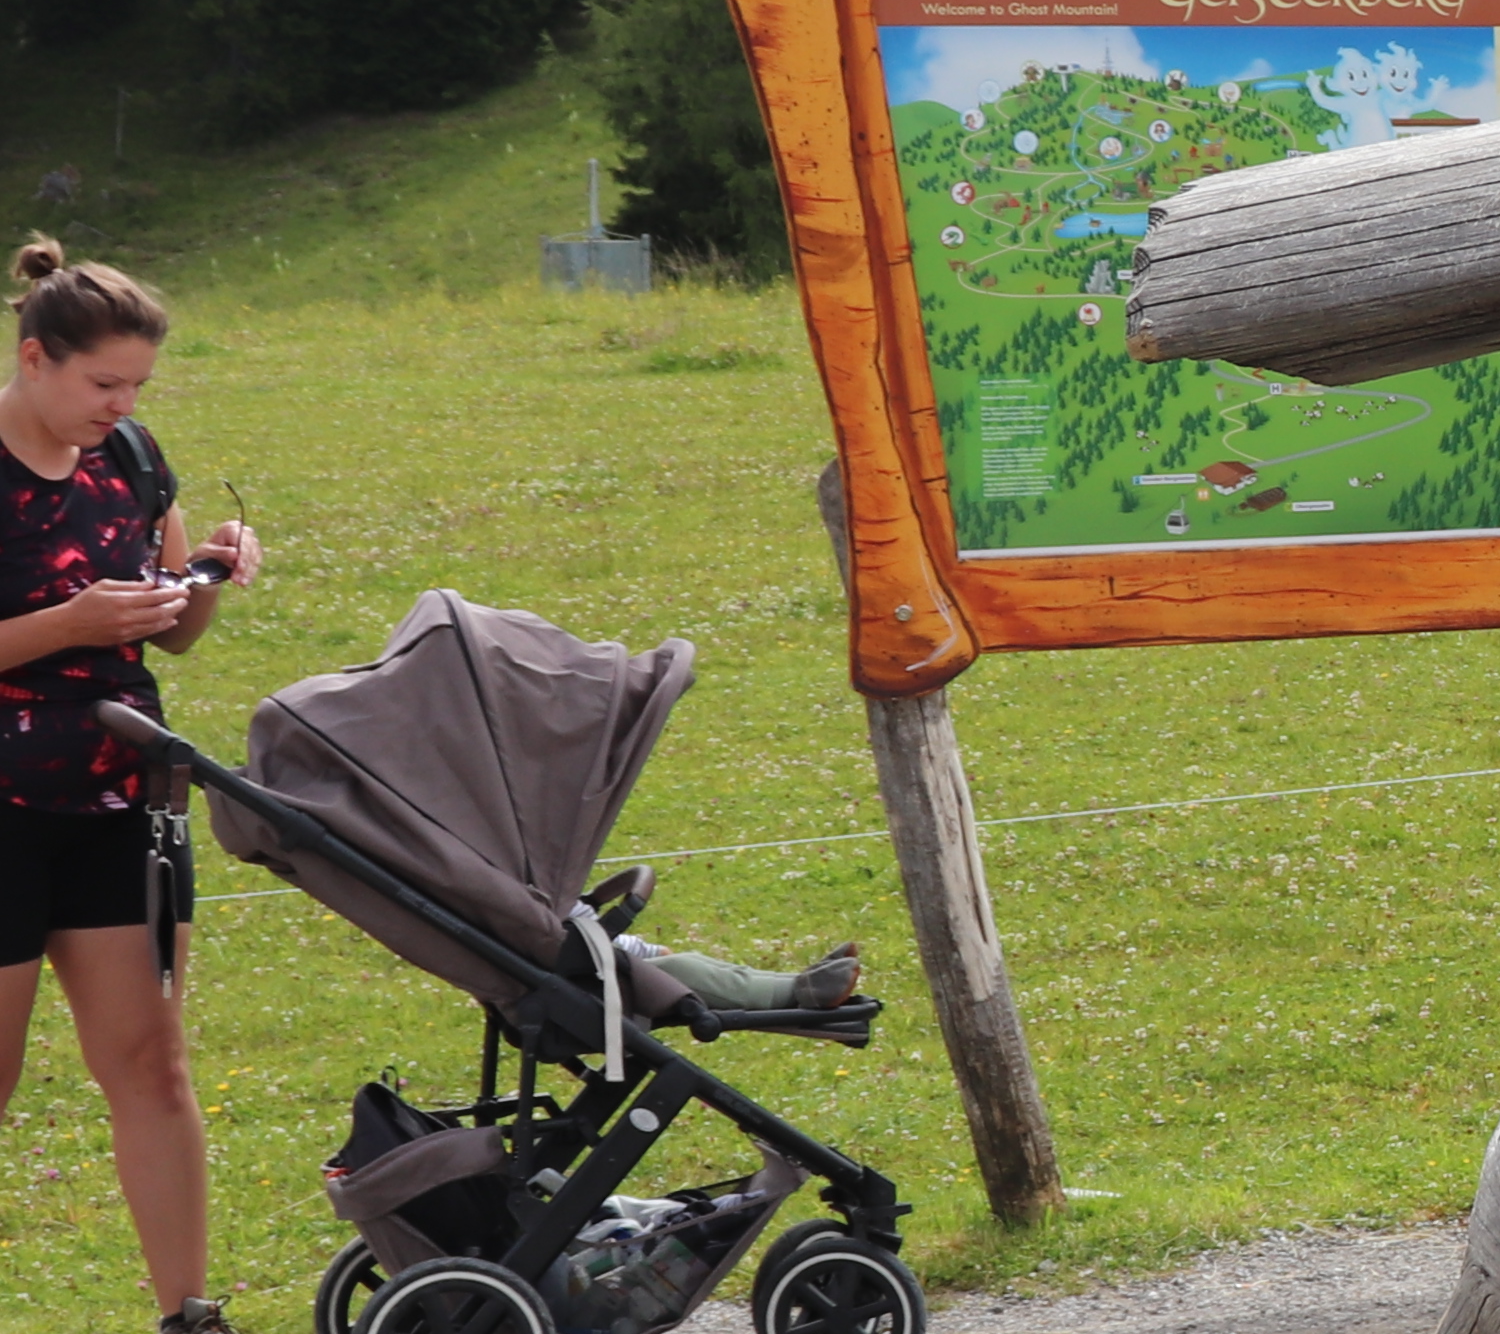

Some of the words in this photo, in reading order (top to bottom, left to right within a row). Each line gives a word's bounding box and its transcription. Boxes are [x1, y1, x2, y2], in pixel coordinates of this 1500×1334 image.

[921, 2, 985, 16] Welcome
[990, 3, 1004, 16] to
[1008, 2, 1048, 16] Ghost
[1052, 2, 1119, 16] Mountain!
